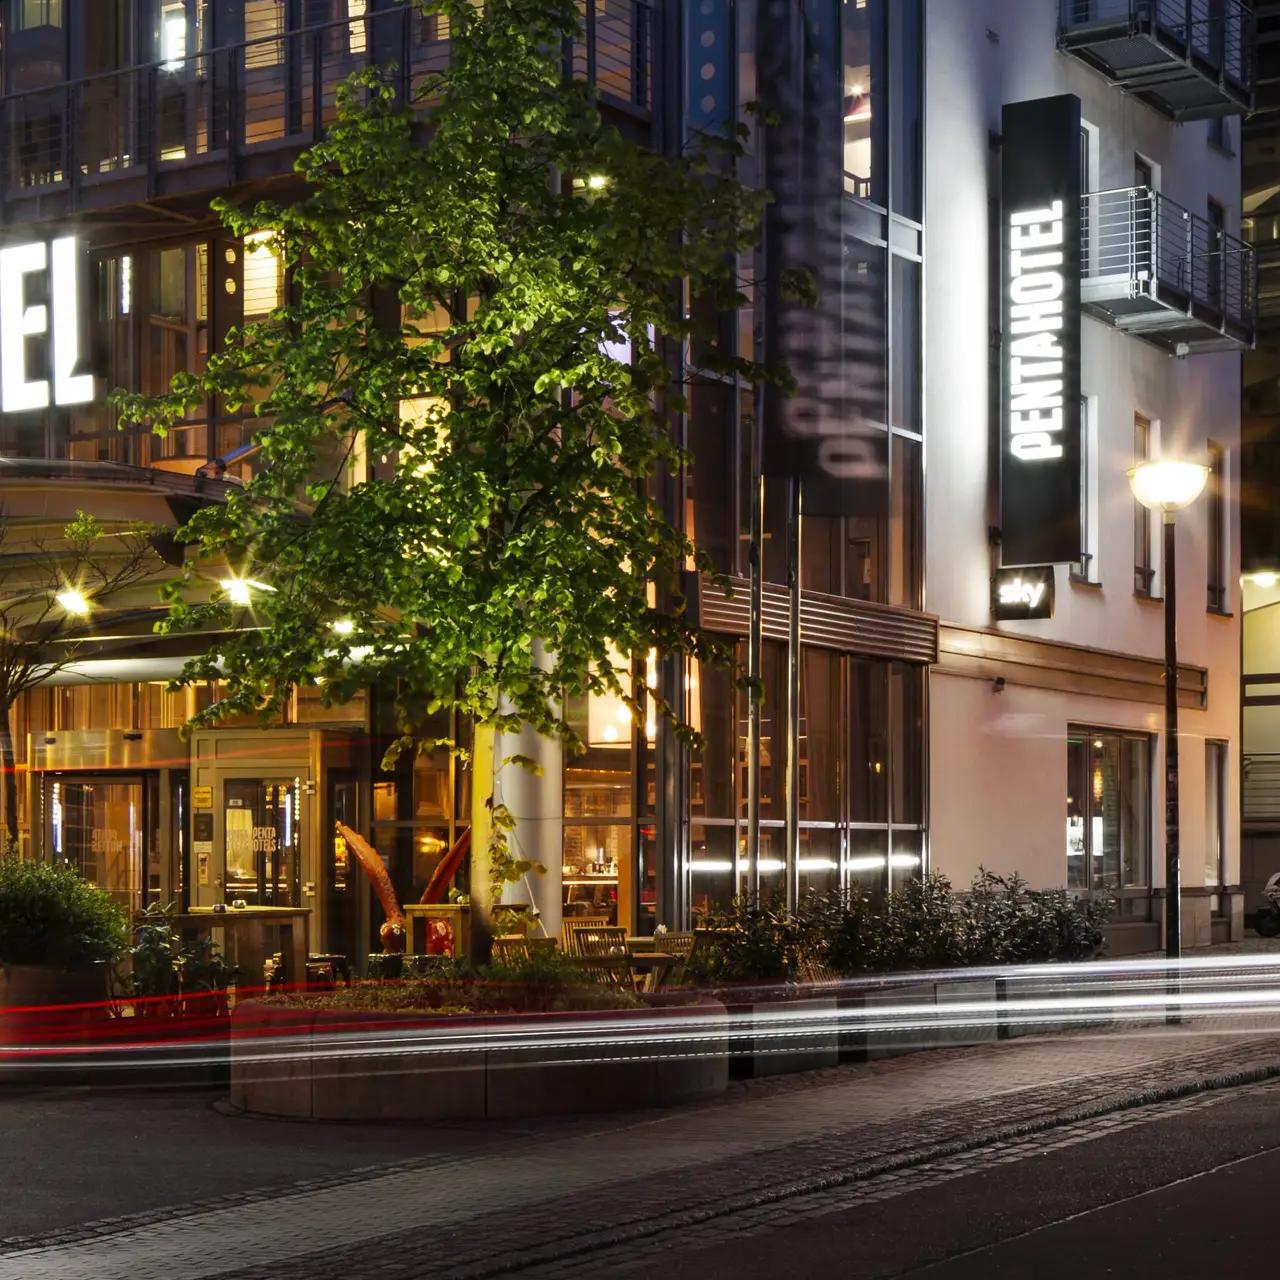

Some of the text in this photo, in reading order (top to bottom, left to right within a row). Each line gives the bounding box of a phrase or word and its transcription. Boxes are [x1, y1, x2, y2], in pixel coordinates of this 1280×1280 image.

[1010, 200, 1063, 461] PENTAHOTEL
[999, 577, 1045, 608] sky
[252, 826, 277, 839] PENTA
